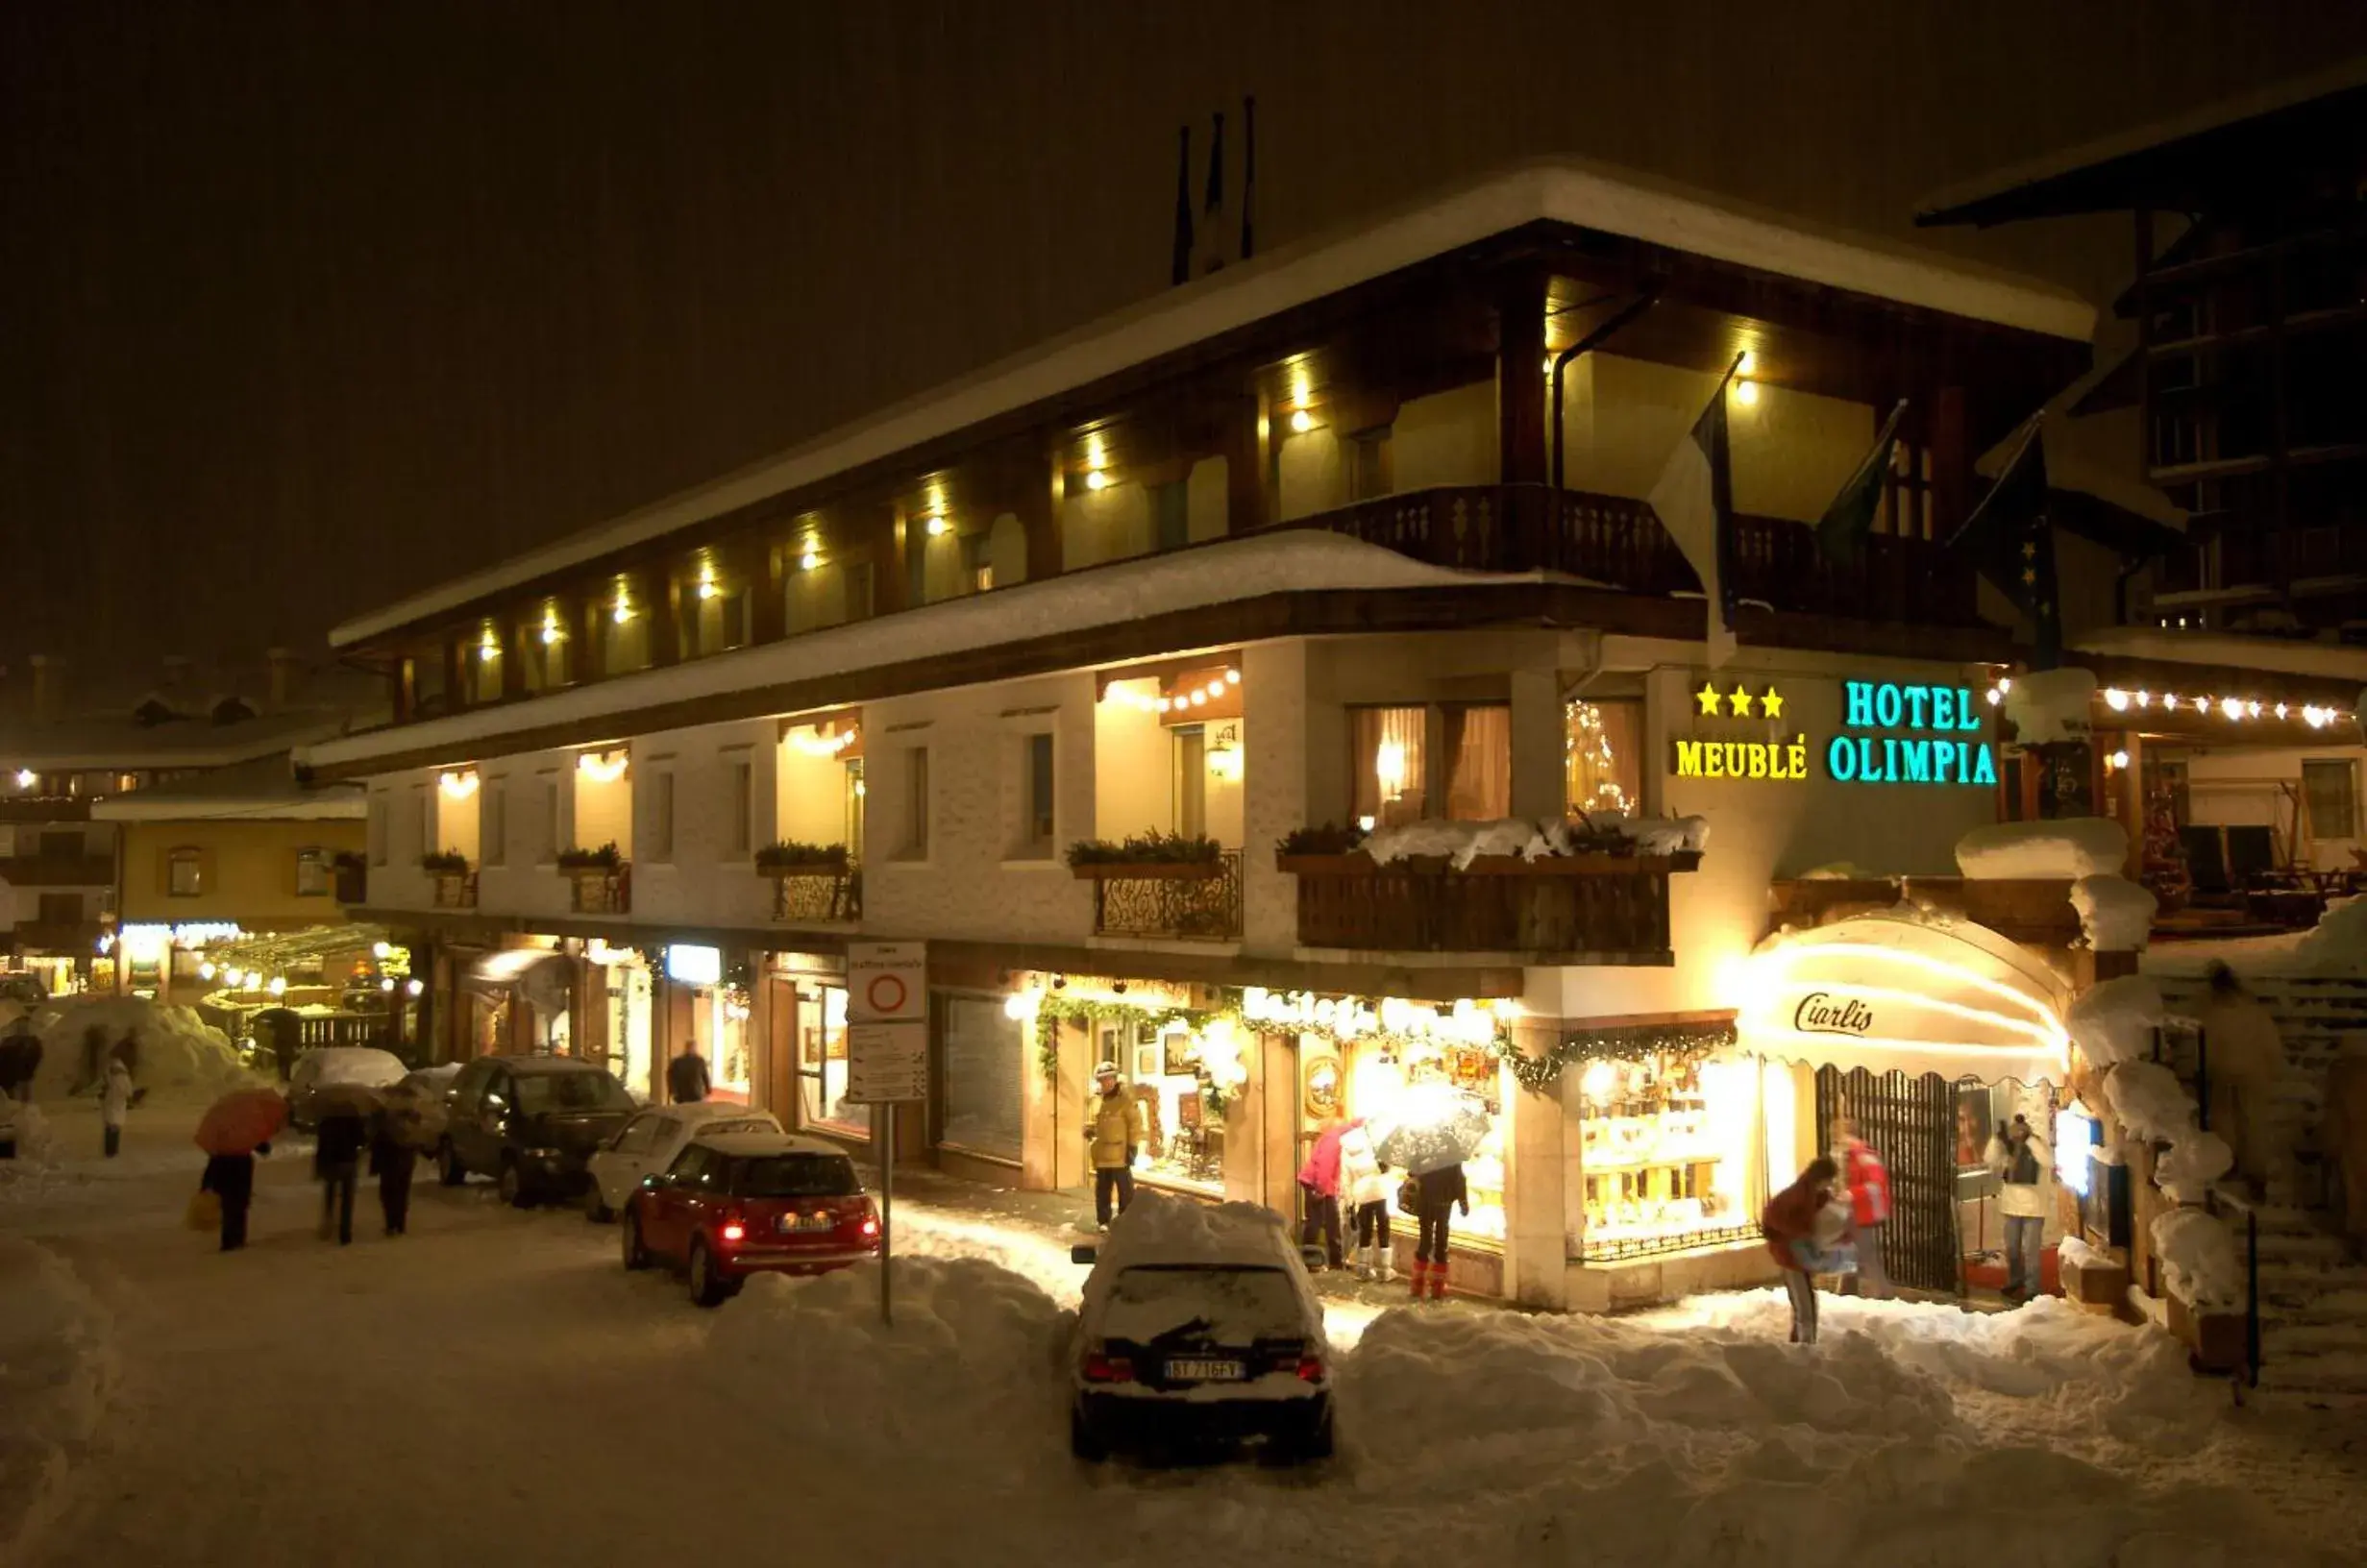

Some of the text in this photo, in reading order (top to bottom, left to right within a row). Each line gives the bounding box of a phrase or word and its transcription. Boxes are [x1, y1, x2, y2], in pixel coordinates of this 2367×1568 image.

[1845, 681, 1981, 730] HOTEL
[1676, 733, 1807, 779] MEUBLÉ
[1830, 736, 1997, 783] OLIMPIA
